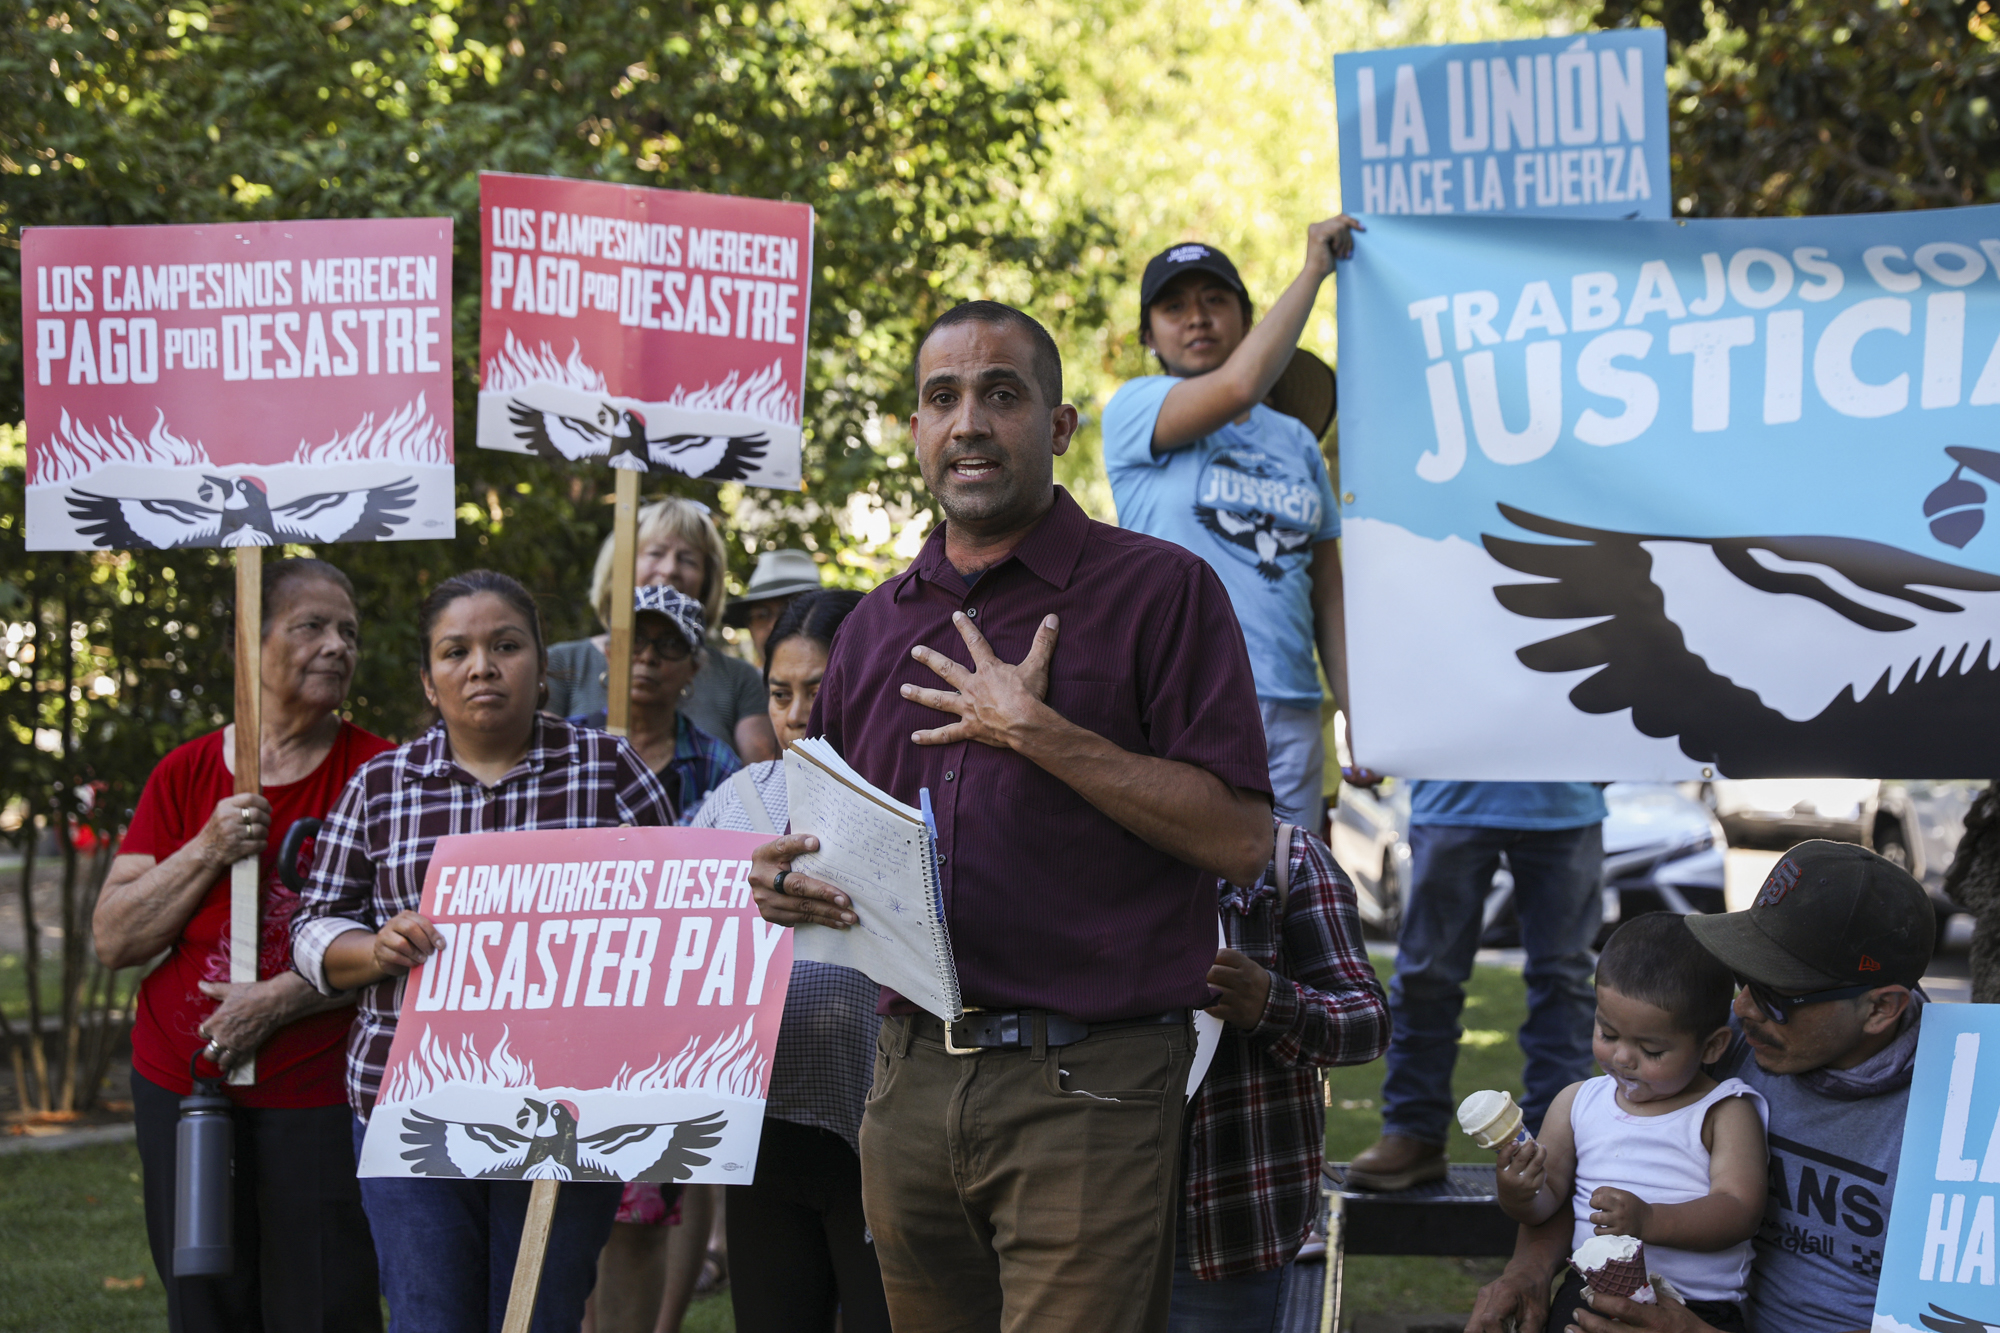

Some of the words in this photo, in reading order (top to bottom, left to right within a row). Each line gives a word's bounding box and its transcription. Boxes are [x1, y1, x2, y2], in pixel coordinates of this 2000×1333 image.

[1357, 64, 1430, 159] LA
[1446, 37, 1646, 153] UNIÓN
[1362, 159, 1454, 215] HACE
[1462, 155, 1505, 211] LA
[1514, 146, 1651, 208] FUERZA
[37, 266, 93, 312] LOS
[102, 260, 293, 312] CAMPESINOS
[301, 255, 437, 304] MERECEN
[491, 206, 536, 250] LOS
[541, 210, 683, 267] CAMPESINOS
[687, 227, 799, 280] MERECEN
[491, 251, 580, 318] PAGO
[582, 270, 619, 313] POR
[619, 265, 799, 345] DESASTRE
[1408, 247, 1845, 360] TRABAJOS
[36, 317, 159, 386] PAGO
[164, 327, 218, 370] POR
[221, 306, 441, 382] DESASTRE
[432, 859, 655, 916] FARMWORKERS
[654, 858, 754, 910] DESER
[415, 916, 662, 1012] DISASTER
[664, 916, 787, 1006] PAY
[1768, 1153, 1884, 1238] ANS
[1918, 1193, 2000, 1287] HA
